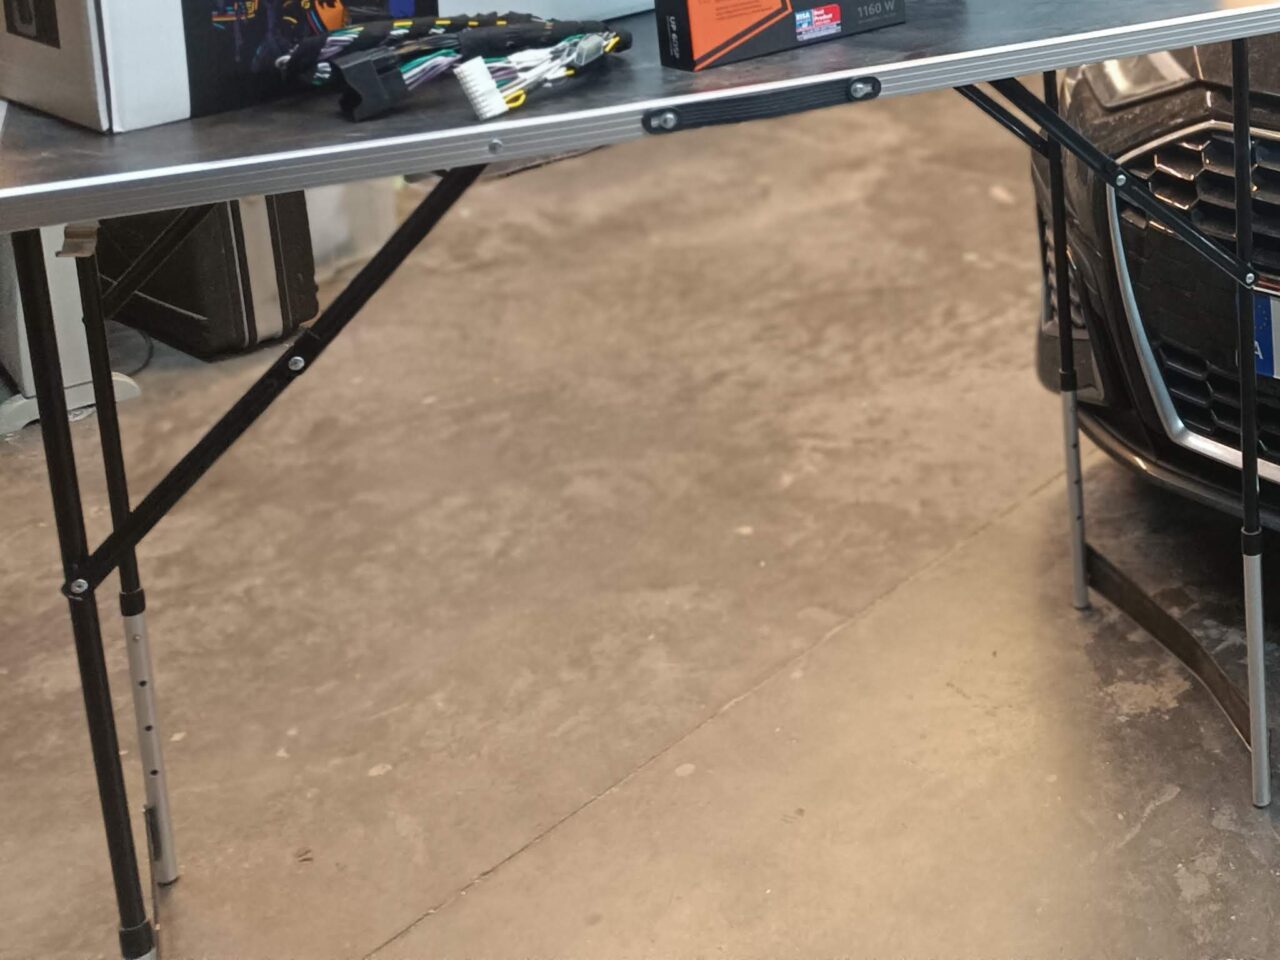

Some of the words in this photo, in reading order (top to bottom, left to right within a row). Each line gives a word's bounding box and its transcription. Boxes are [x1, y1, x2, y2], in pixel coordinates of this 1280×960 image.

[857, 2, 882, 17] 1160
[884, 0, 895, 11] W
[670, 16, 677, 31] UP
